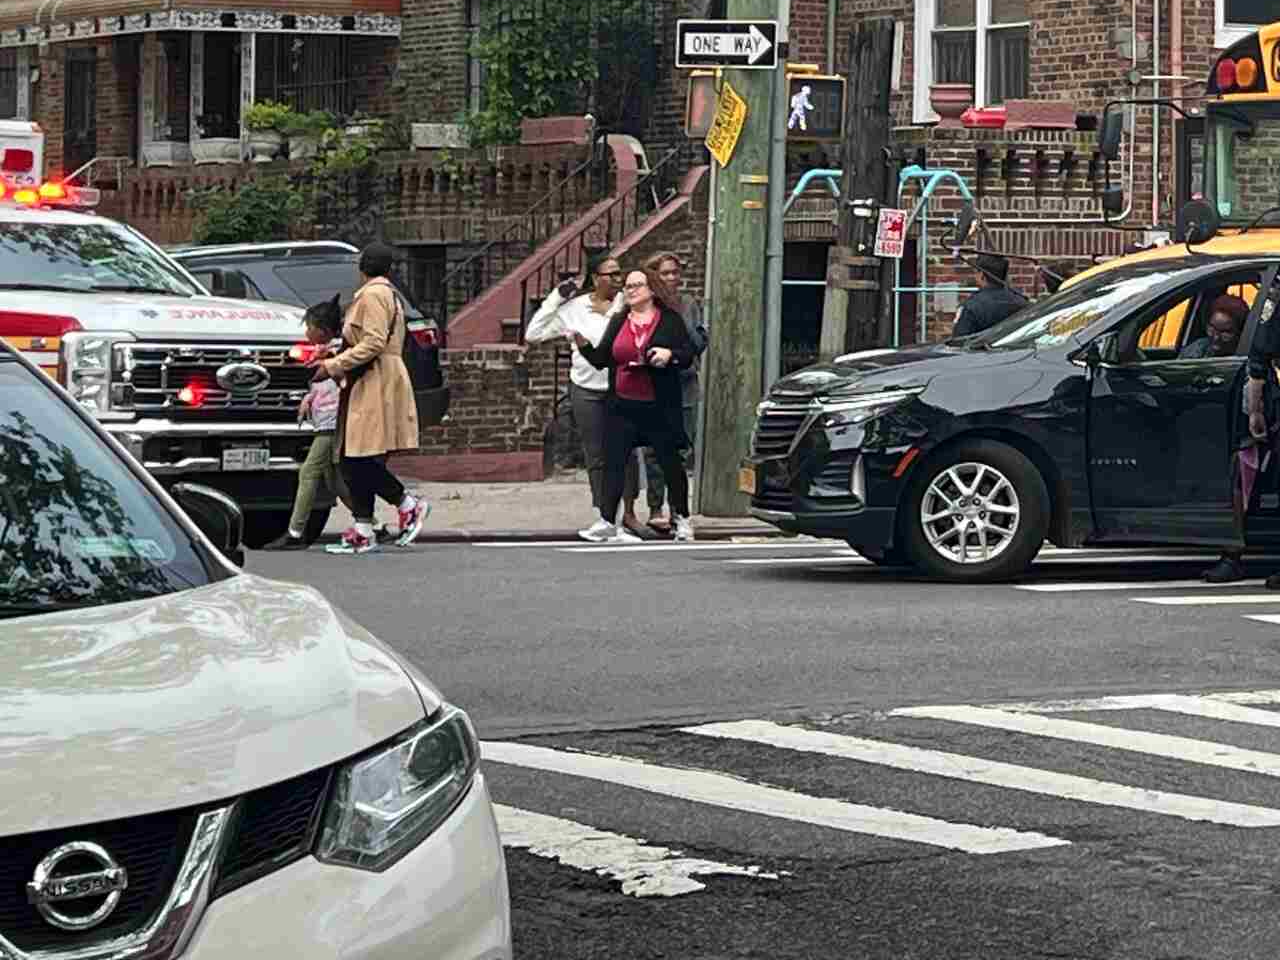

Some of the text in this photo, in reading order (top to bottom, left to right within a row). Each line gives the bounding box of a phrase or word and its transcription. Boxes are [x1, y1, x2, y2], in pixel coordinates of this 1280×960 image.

[693, 36, 762, 53] ONE WAY
[40, 870, 120, 897] NISSAN
